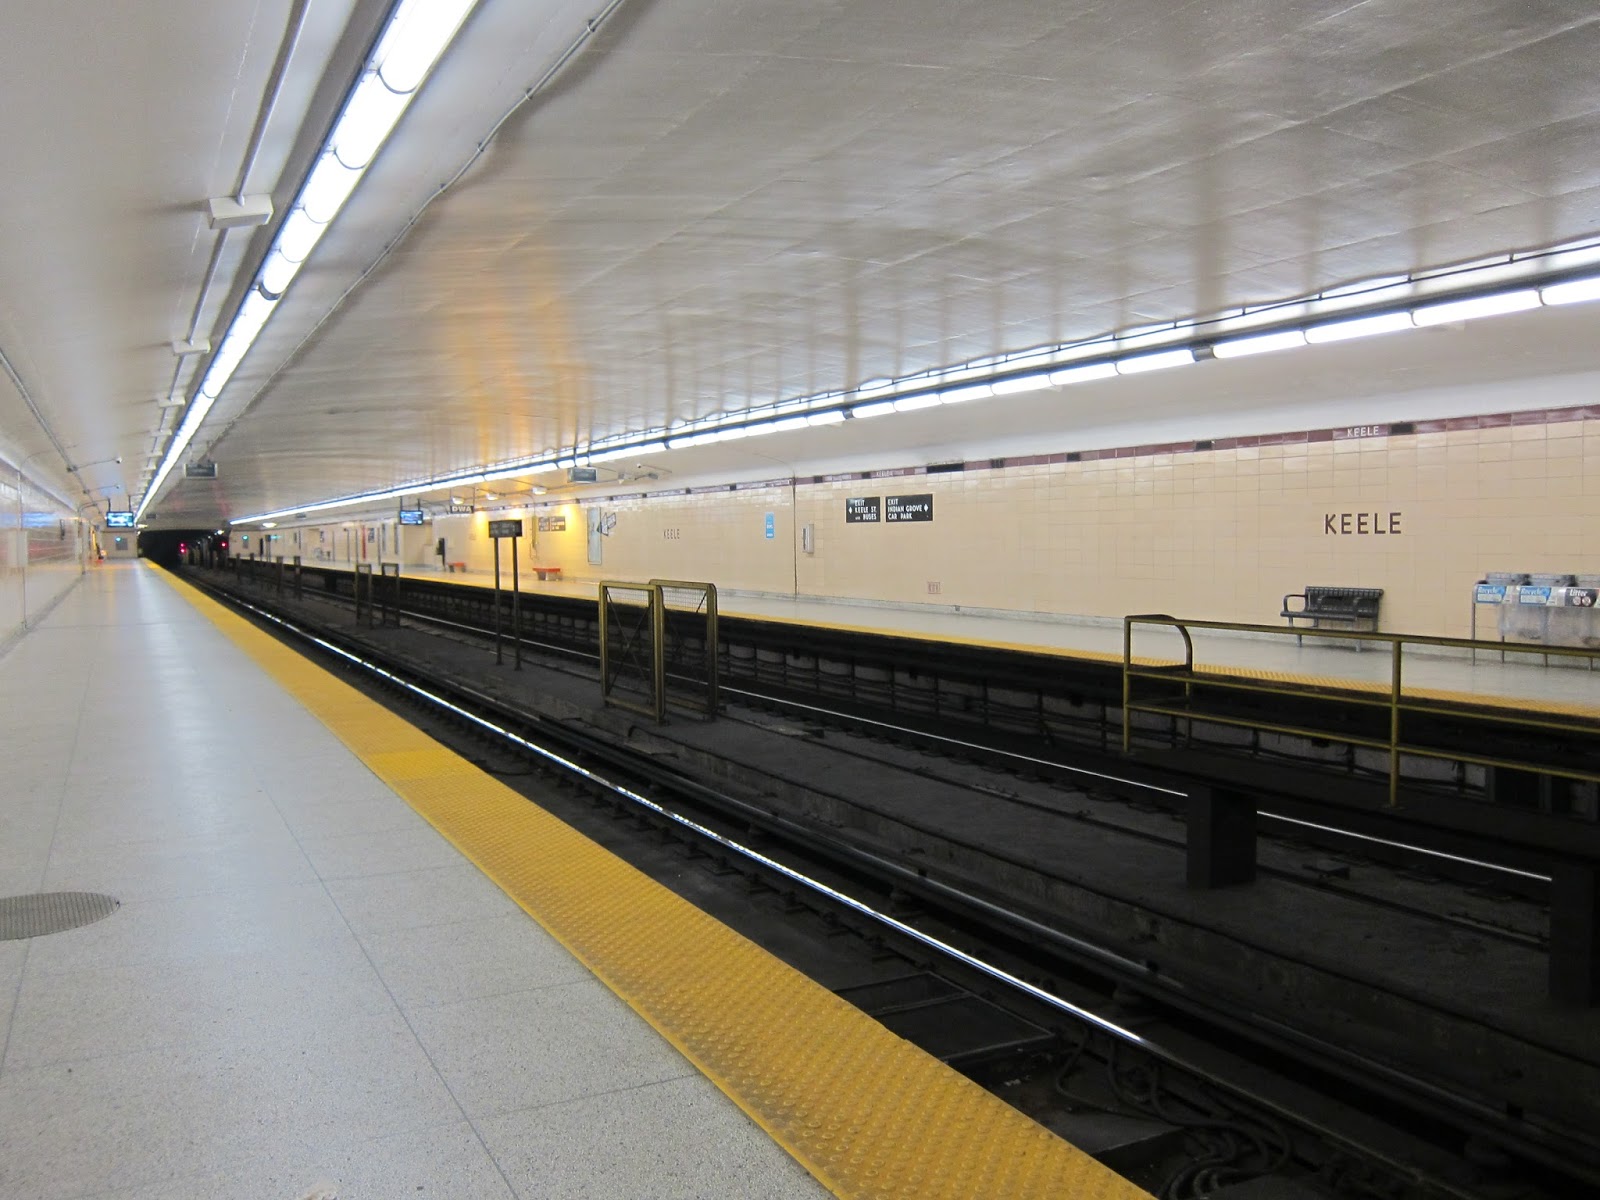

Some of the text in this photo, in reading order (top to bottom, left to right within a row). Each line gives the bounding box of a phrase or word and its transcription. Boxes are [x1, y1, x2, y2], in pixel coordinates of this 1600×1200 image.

[1347, 425, 1380, 437] KEELE
[888, 505, 904, 513] INDIAN
[1325, 512, 1402, 535] KEELE
[663, 529, 680, 539] KEELE
[1570, 589, 1588, 597] Litter
